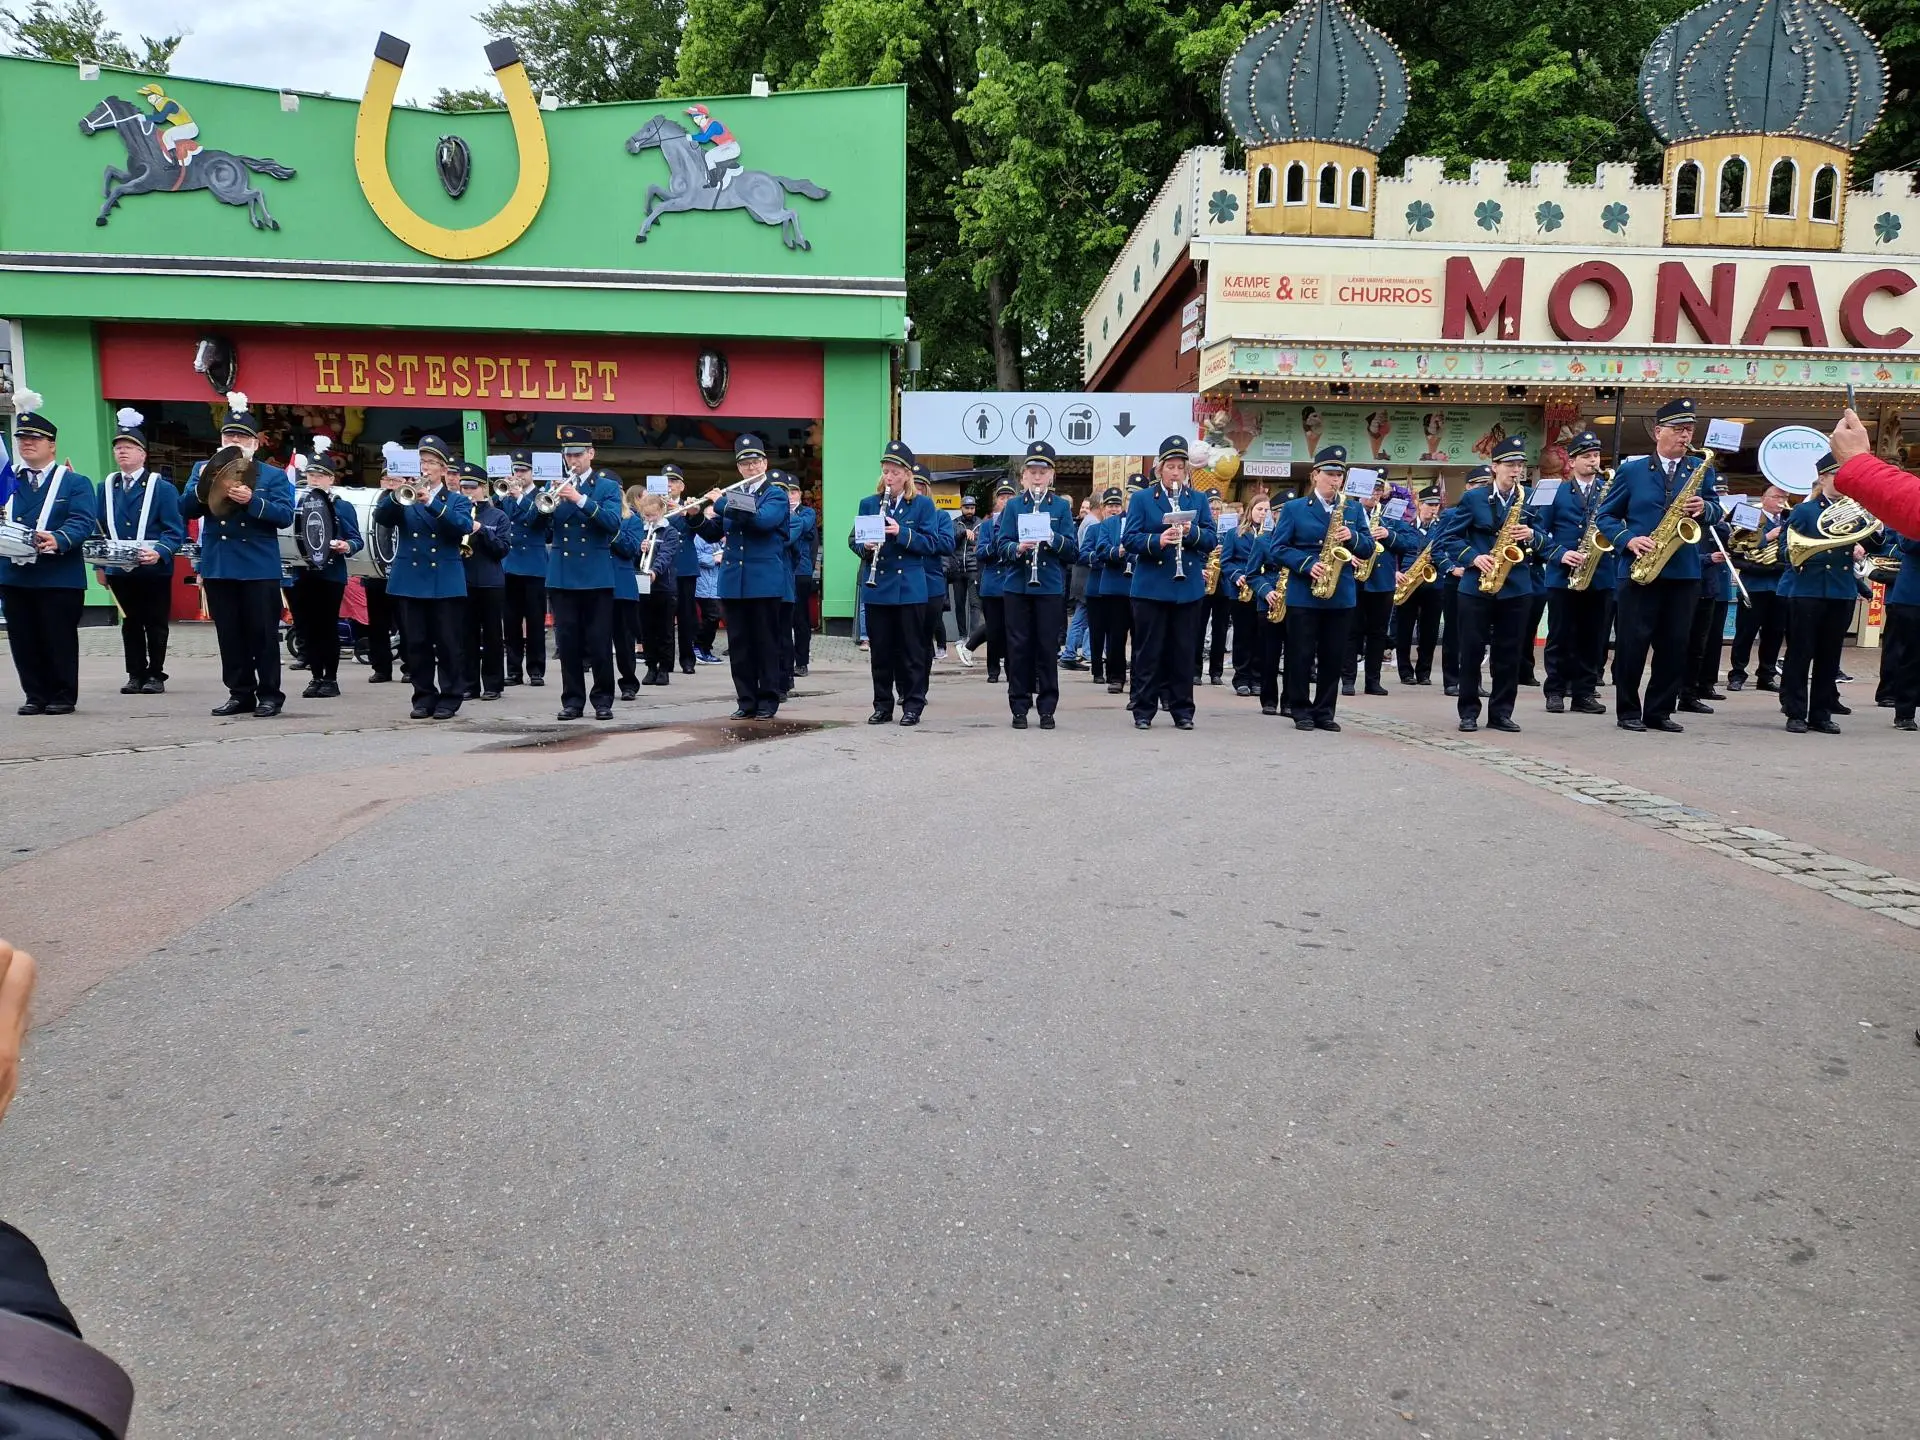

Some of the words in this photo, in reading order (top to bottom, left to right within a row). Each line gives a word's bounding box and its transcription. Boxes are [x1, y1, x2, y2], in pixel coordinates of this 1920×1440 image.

[1224, 276, 1271, 289] KÆMPE
[1276, 275, 1293, 300] &
[1222, 289, 1271, 298] GAMMELDAGS
[1300, 287, 1318, 299] ICE
[1338, 286, 1433, 304] CHURROS
[1441, 256, 1918, 349] MONAC
[314, 352, 618, 401] HESTESPILLET
[1771, 442, 1823, 451] AMICITIA
[1245, 465, 1289, 476] CHURROS
